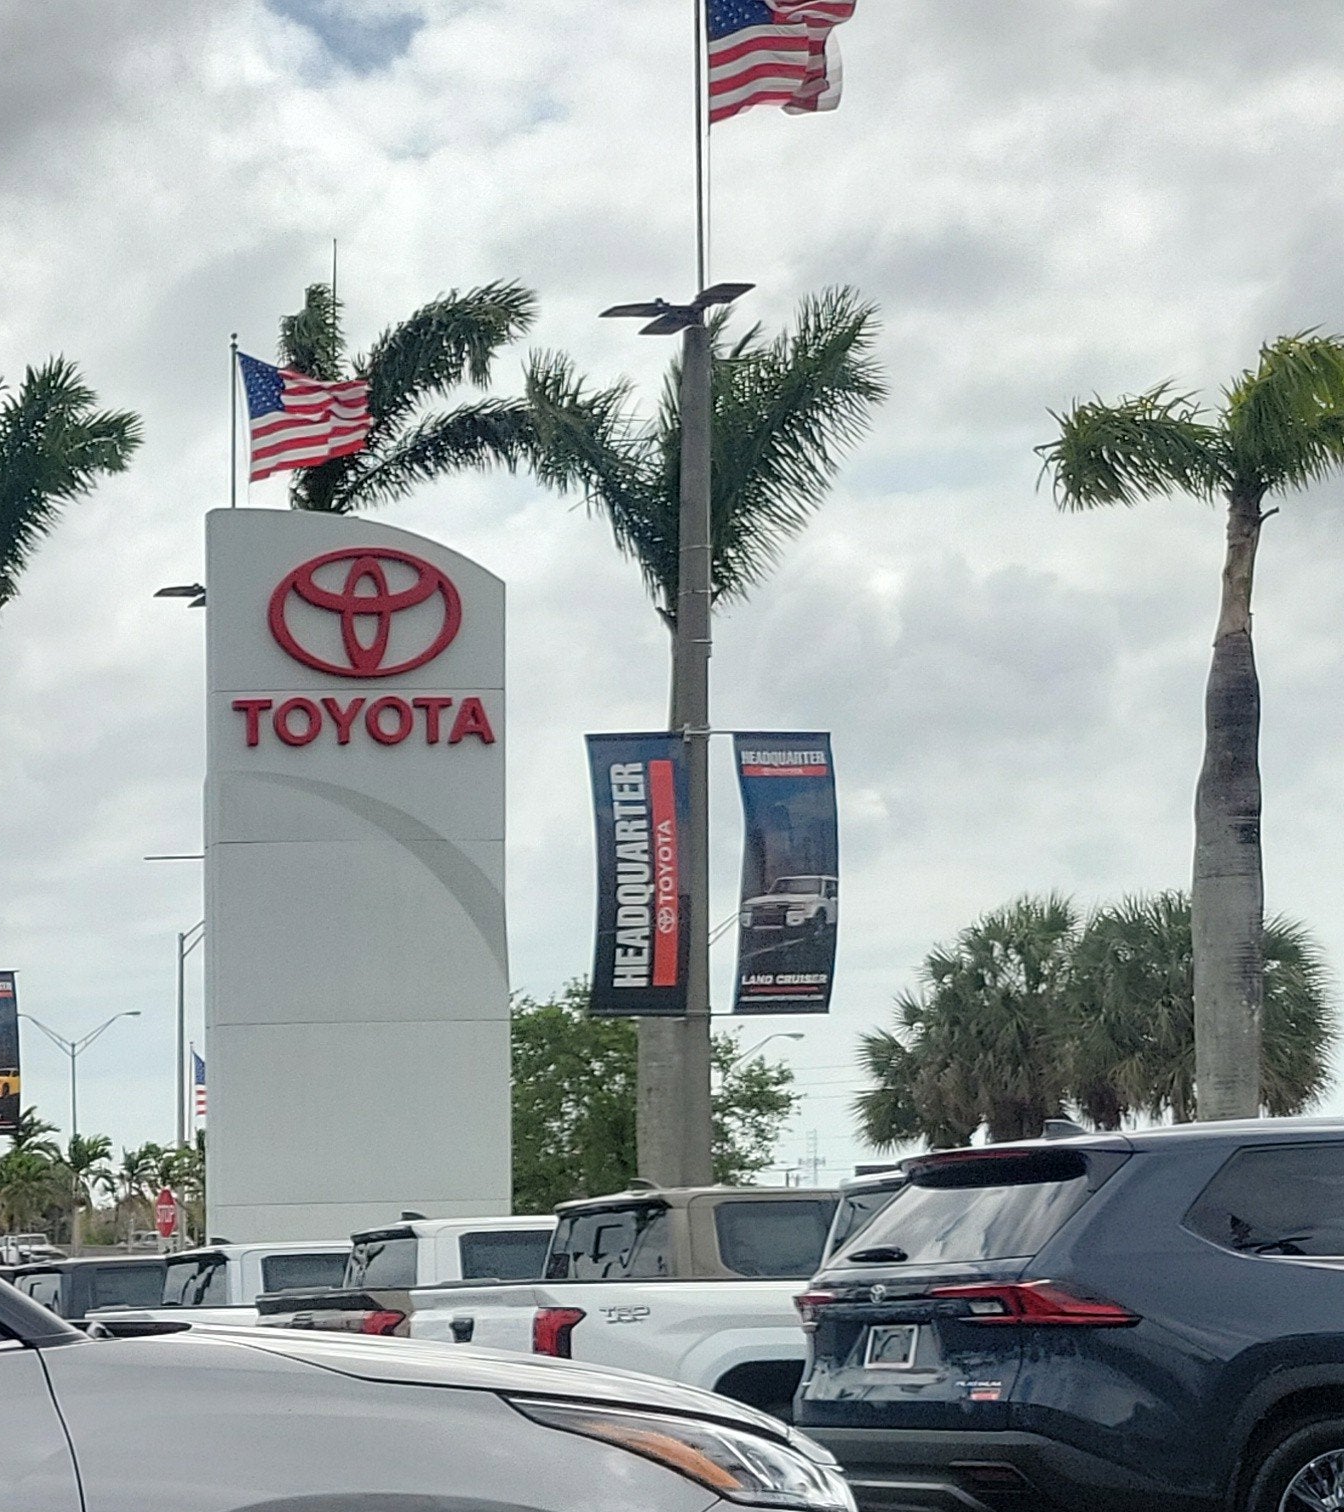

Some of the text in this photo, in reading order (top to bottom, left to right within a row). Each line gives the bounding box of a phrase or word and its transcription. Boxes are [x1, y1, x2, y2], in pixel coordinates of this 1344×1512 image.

[231, 696, 496, 747] TOYOTA
[610, 762, 654, 987] HEADQUARTER
[657, 819, 675, 904] TOYOTA
[741, 974, 827, 985] LAND CRUISER
